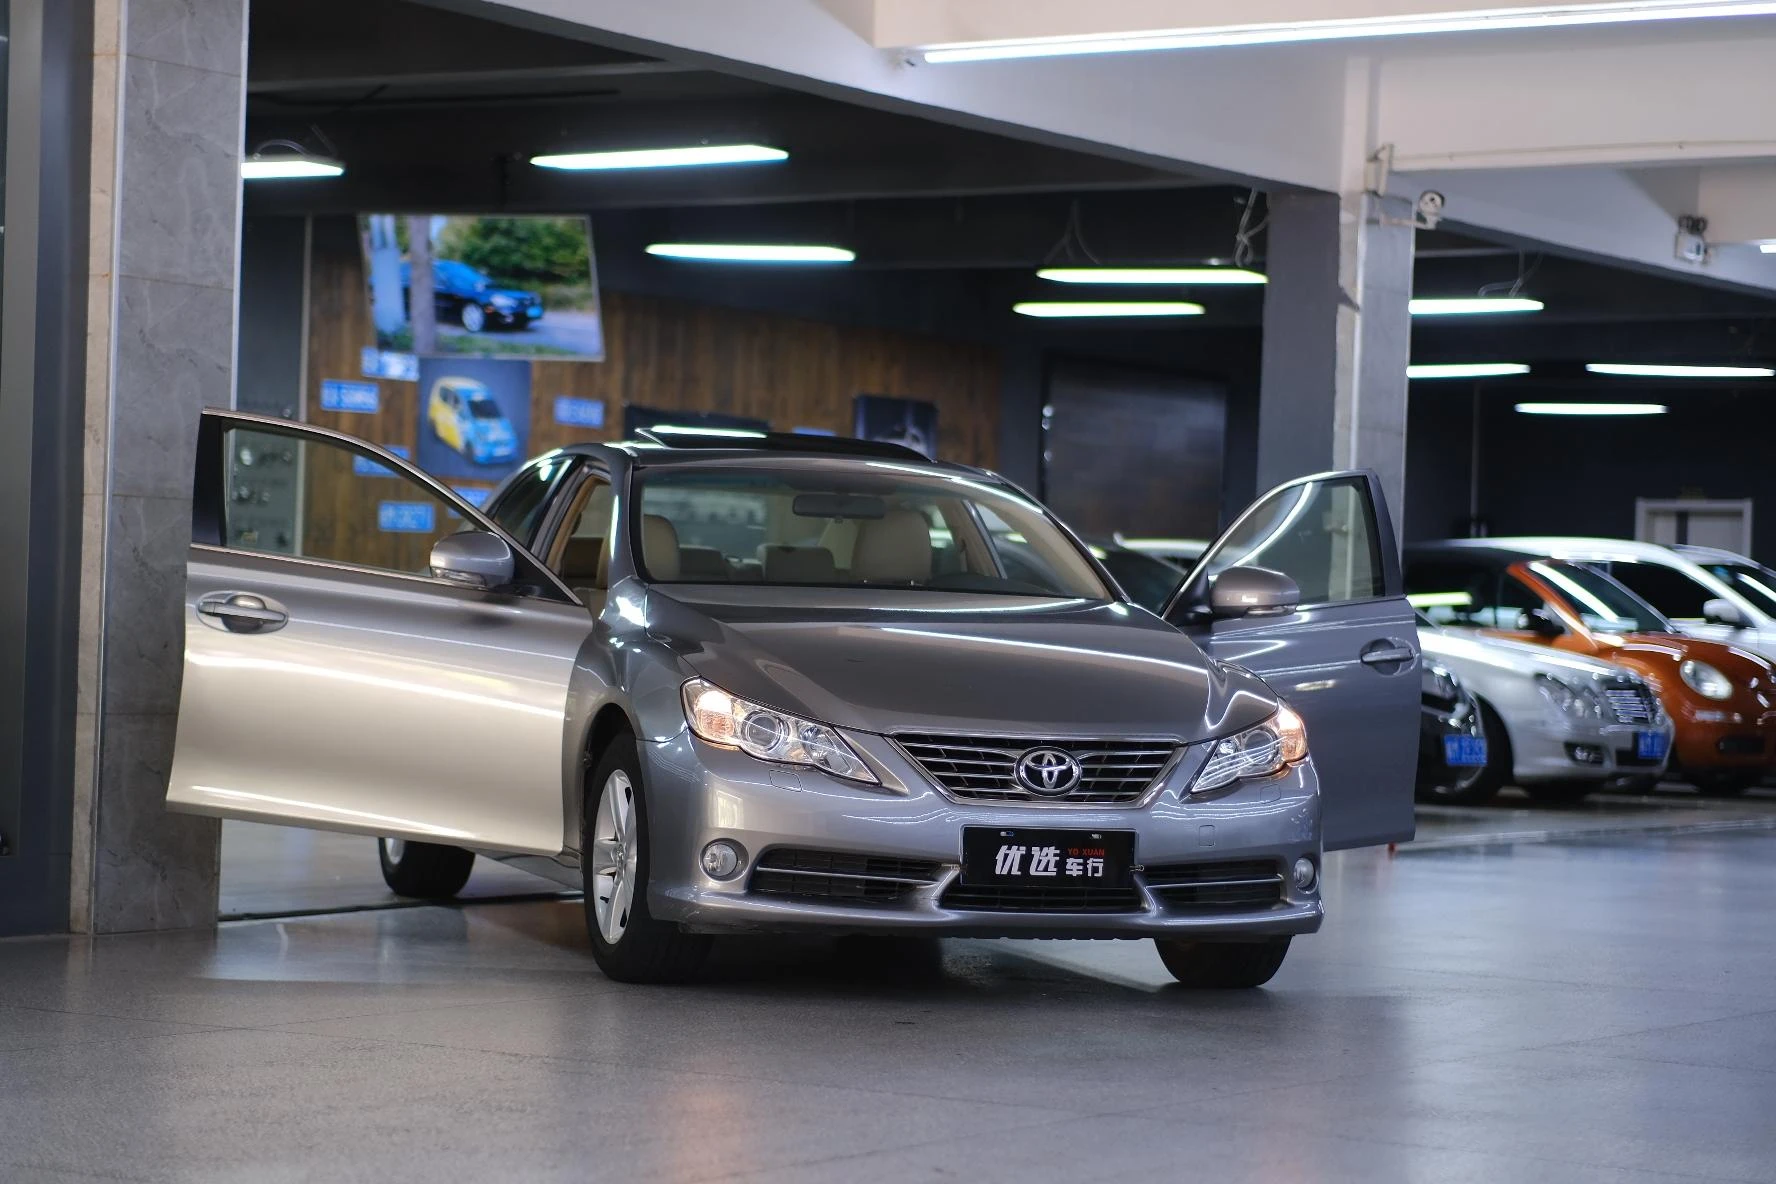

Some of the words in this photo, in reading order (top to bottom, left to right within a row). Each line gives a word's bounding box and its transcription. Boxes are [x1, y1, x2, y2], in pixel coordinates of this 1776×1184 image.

[995, 845, 1060, 876] 优选
[1065, 858, 1104, 877] 车行
[1082, 848, 1105, 856] XUAN
